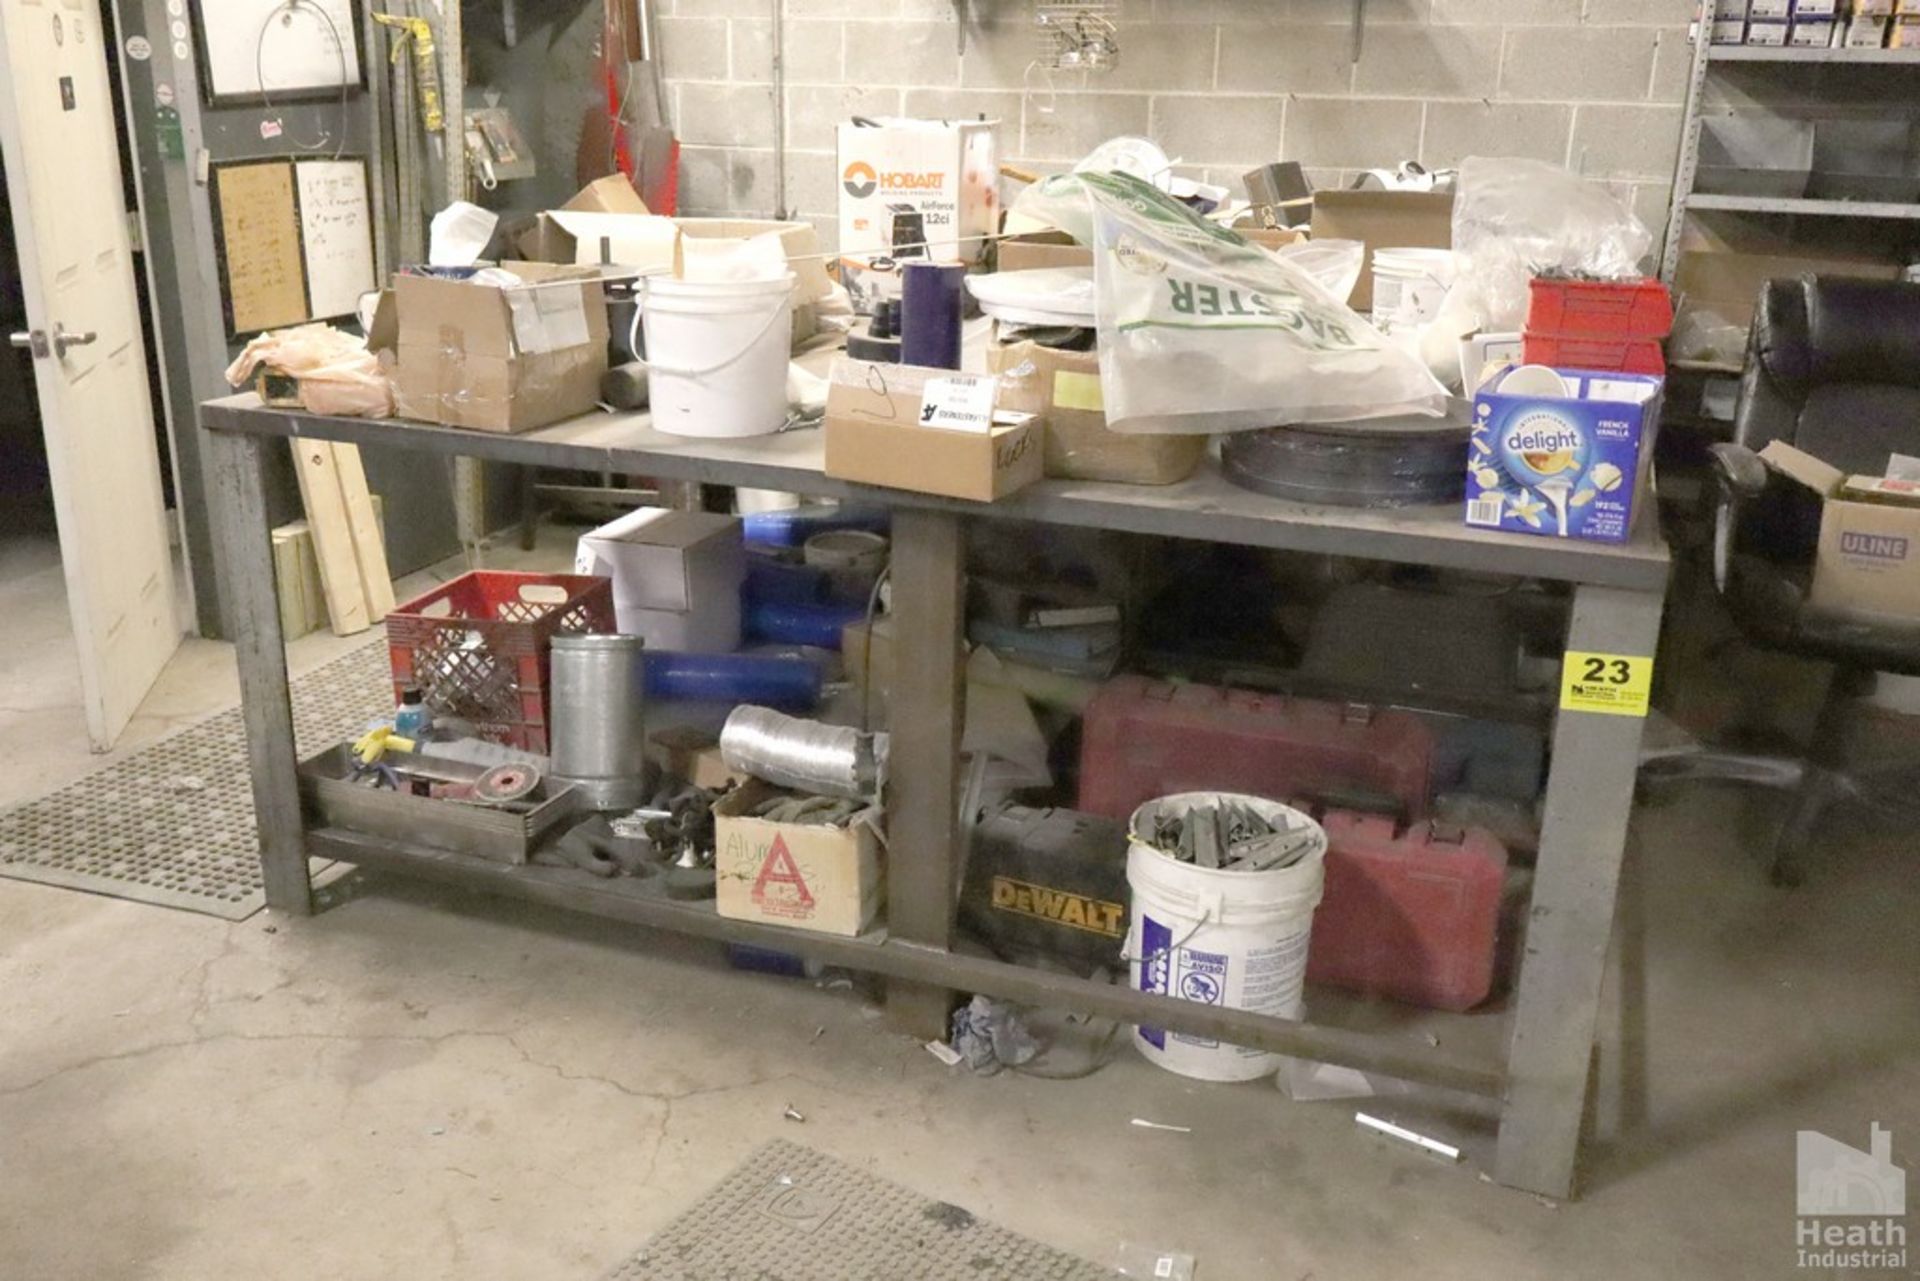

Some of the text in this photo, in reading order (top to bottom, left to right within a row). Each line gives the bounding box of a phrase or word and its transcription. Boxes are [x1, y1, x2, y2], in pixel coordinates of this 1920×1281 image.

[880, 173, 945, 189] HOBART
[925, 213, 950, 224] 12ci
[1595, 428, 1630, 437] VANILLA
[1597, 420, 1629, 429] FRENCH
[1508, 430, 1577, 452] delight
[1843, 534, 1905, 557] ULINE
[1583, 658, 1630, 684] 23
